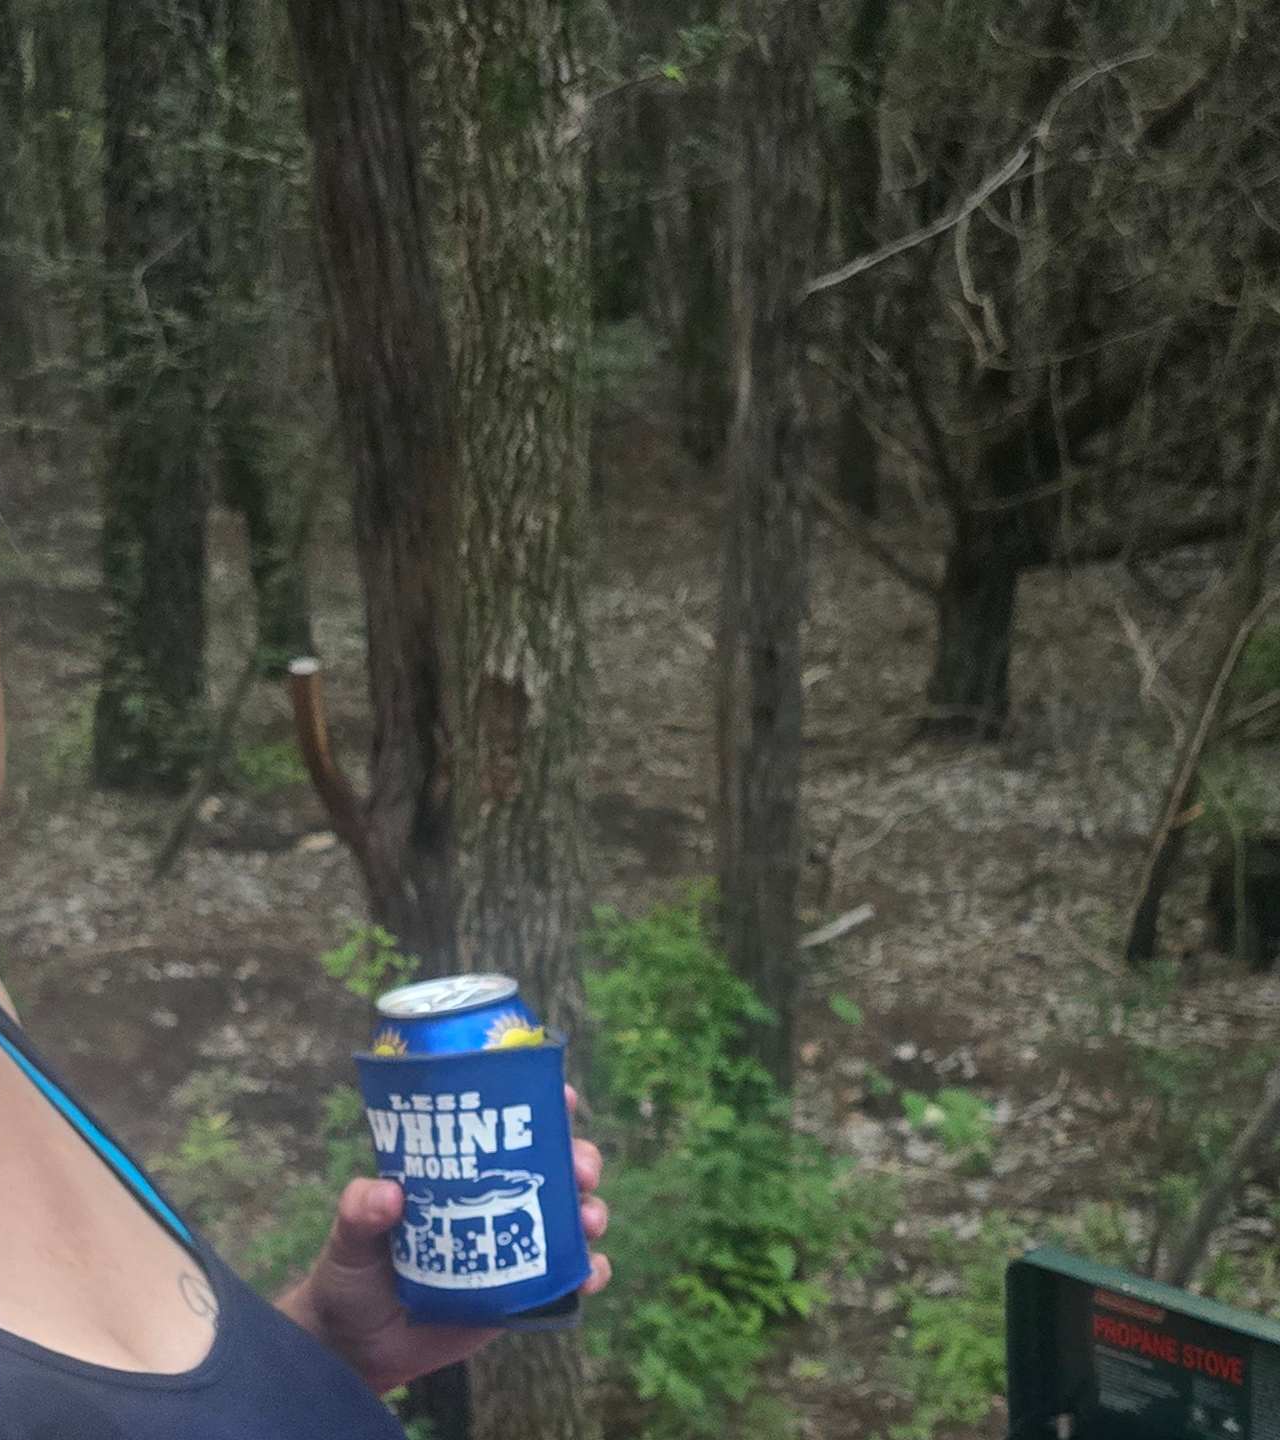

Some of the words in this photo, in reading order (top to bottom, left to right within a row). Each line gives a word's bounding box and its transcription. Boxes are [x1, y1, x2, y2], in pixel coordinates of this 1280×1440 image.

[390, 1092, 480, 1111] LESS
[367, 1104, 533, 1155] WHINE
[404, 1155, 479, 1180] MORE
[1093, 1314, 1180, 1364] PROPANE
[1182, 1343, 1244, 1386] STOVE
